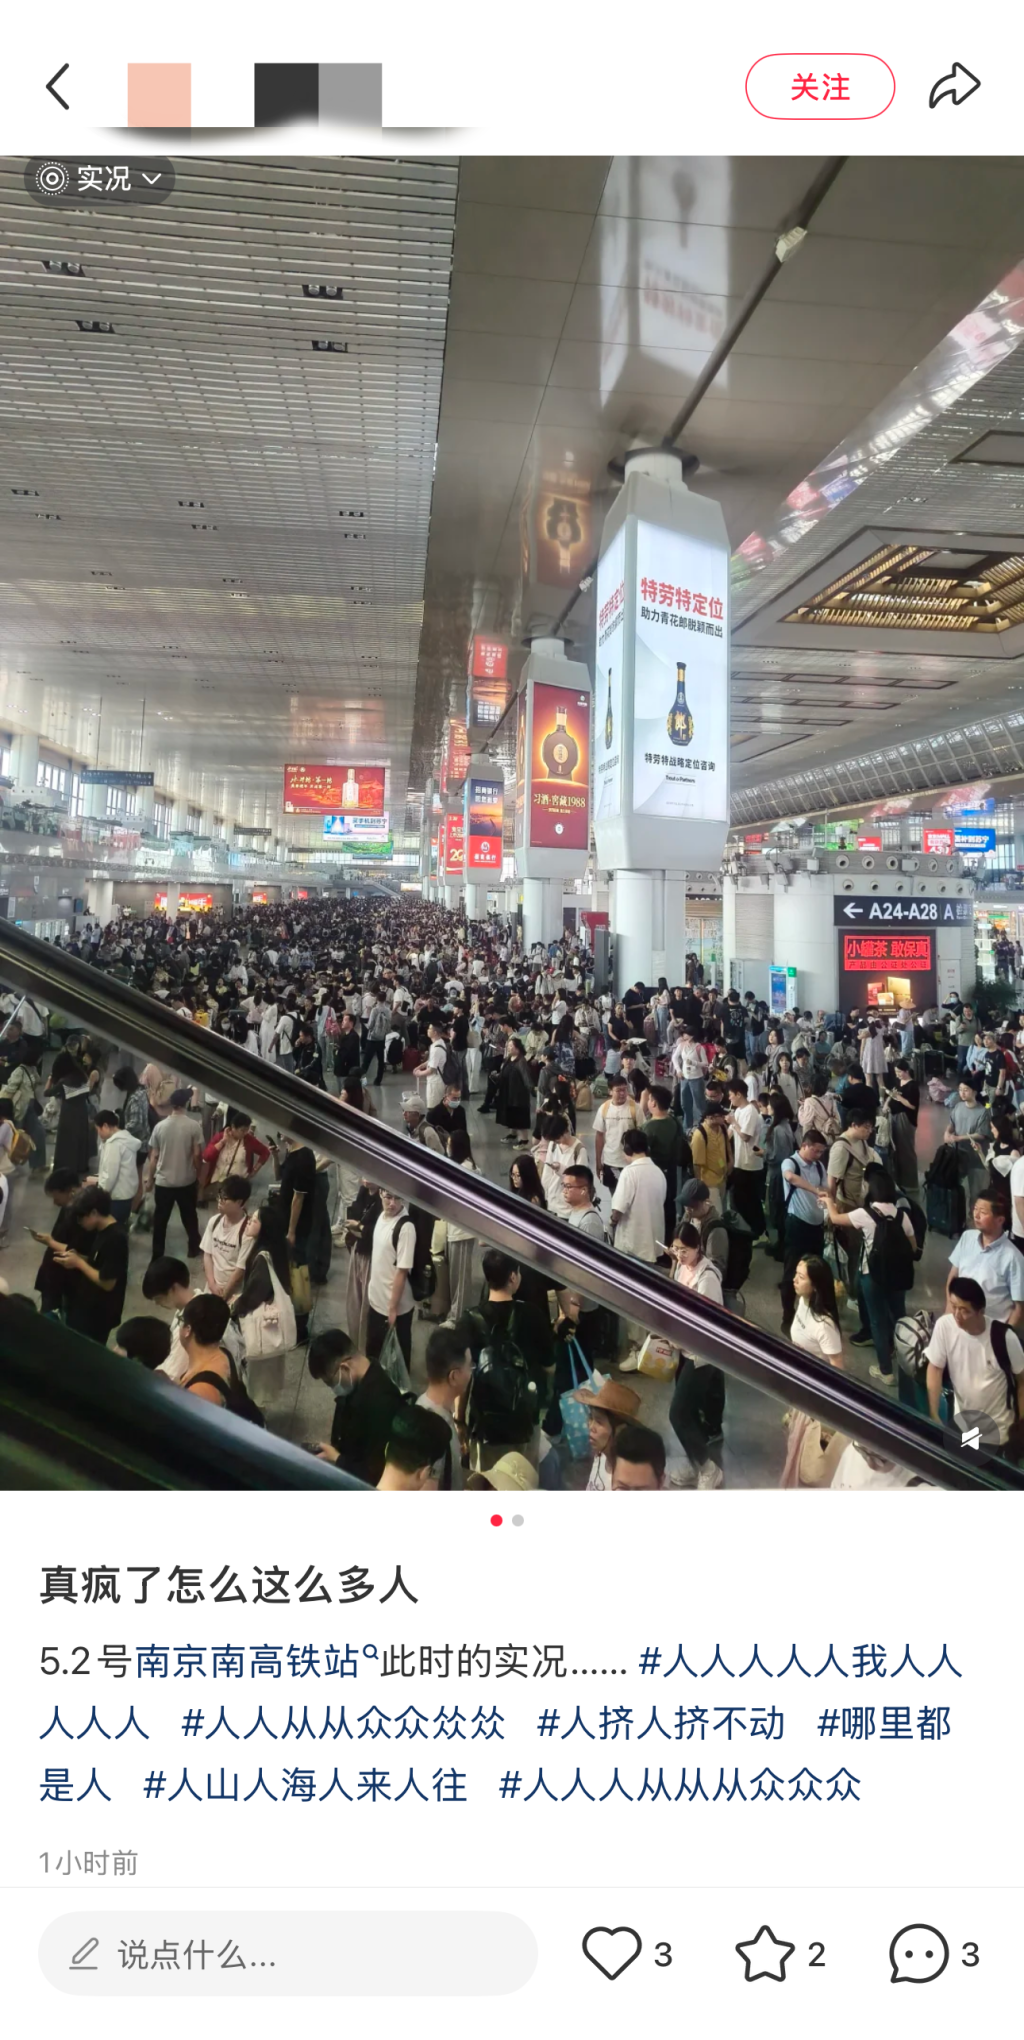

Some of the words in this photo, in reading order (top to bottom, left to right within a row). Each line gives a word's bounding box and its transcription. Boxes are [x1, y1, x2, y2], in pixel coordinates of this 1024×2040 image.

[641, 577, 724, 620] 特劳特定位
[641, 606, 723, 638] 助力青花郎脱颖而出
[645, 752, 716, 772] 特劳特战略定位咨询
[869, 902, 938, 920] A24-A28
[944, 903, 954, 920] A
[847, 940, 888, 957] 小罐茶
[891, 940, 928, 957] 敢保真
